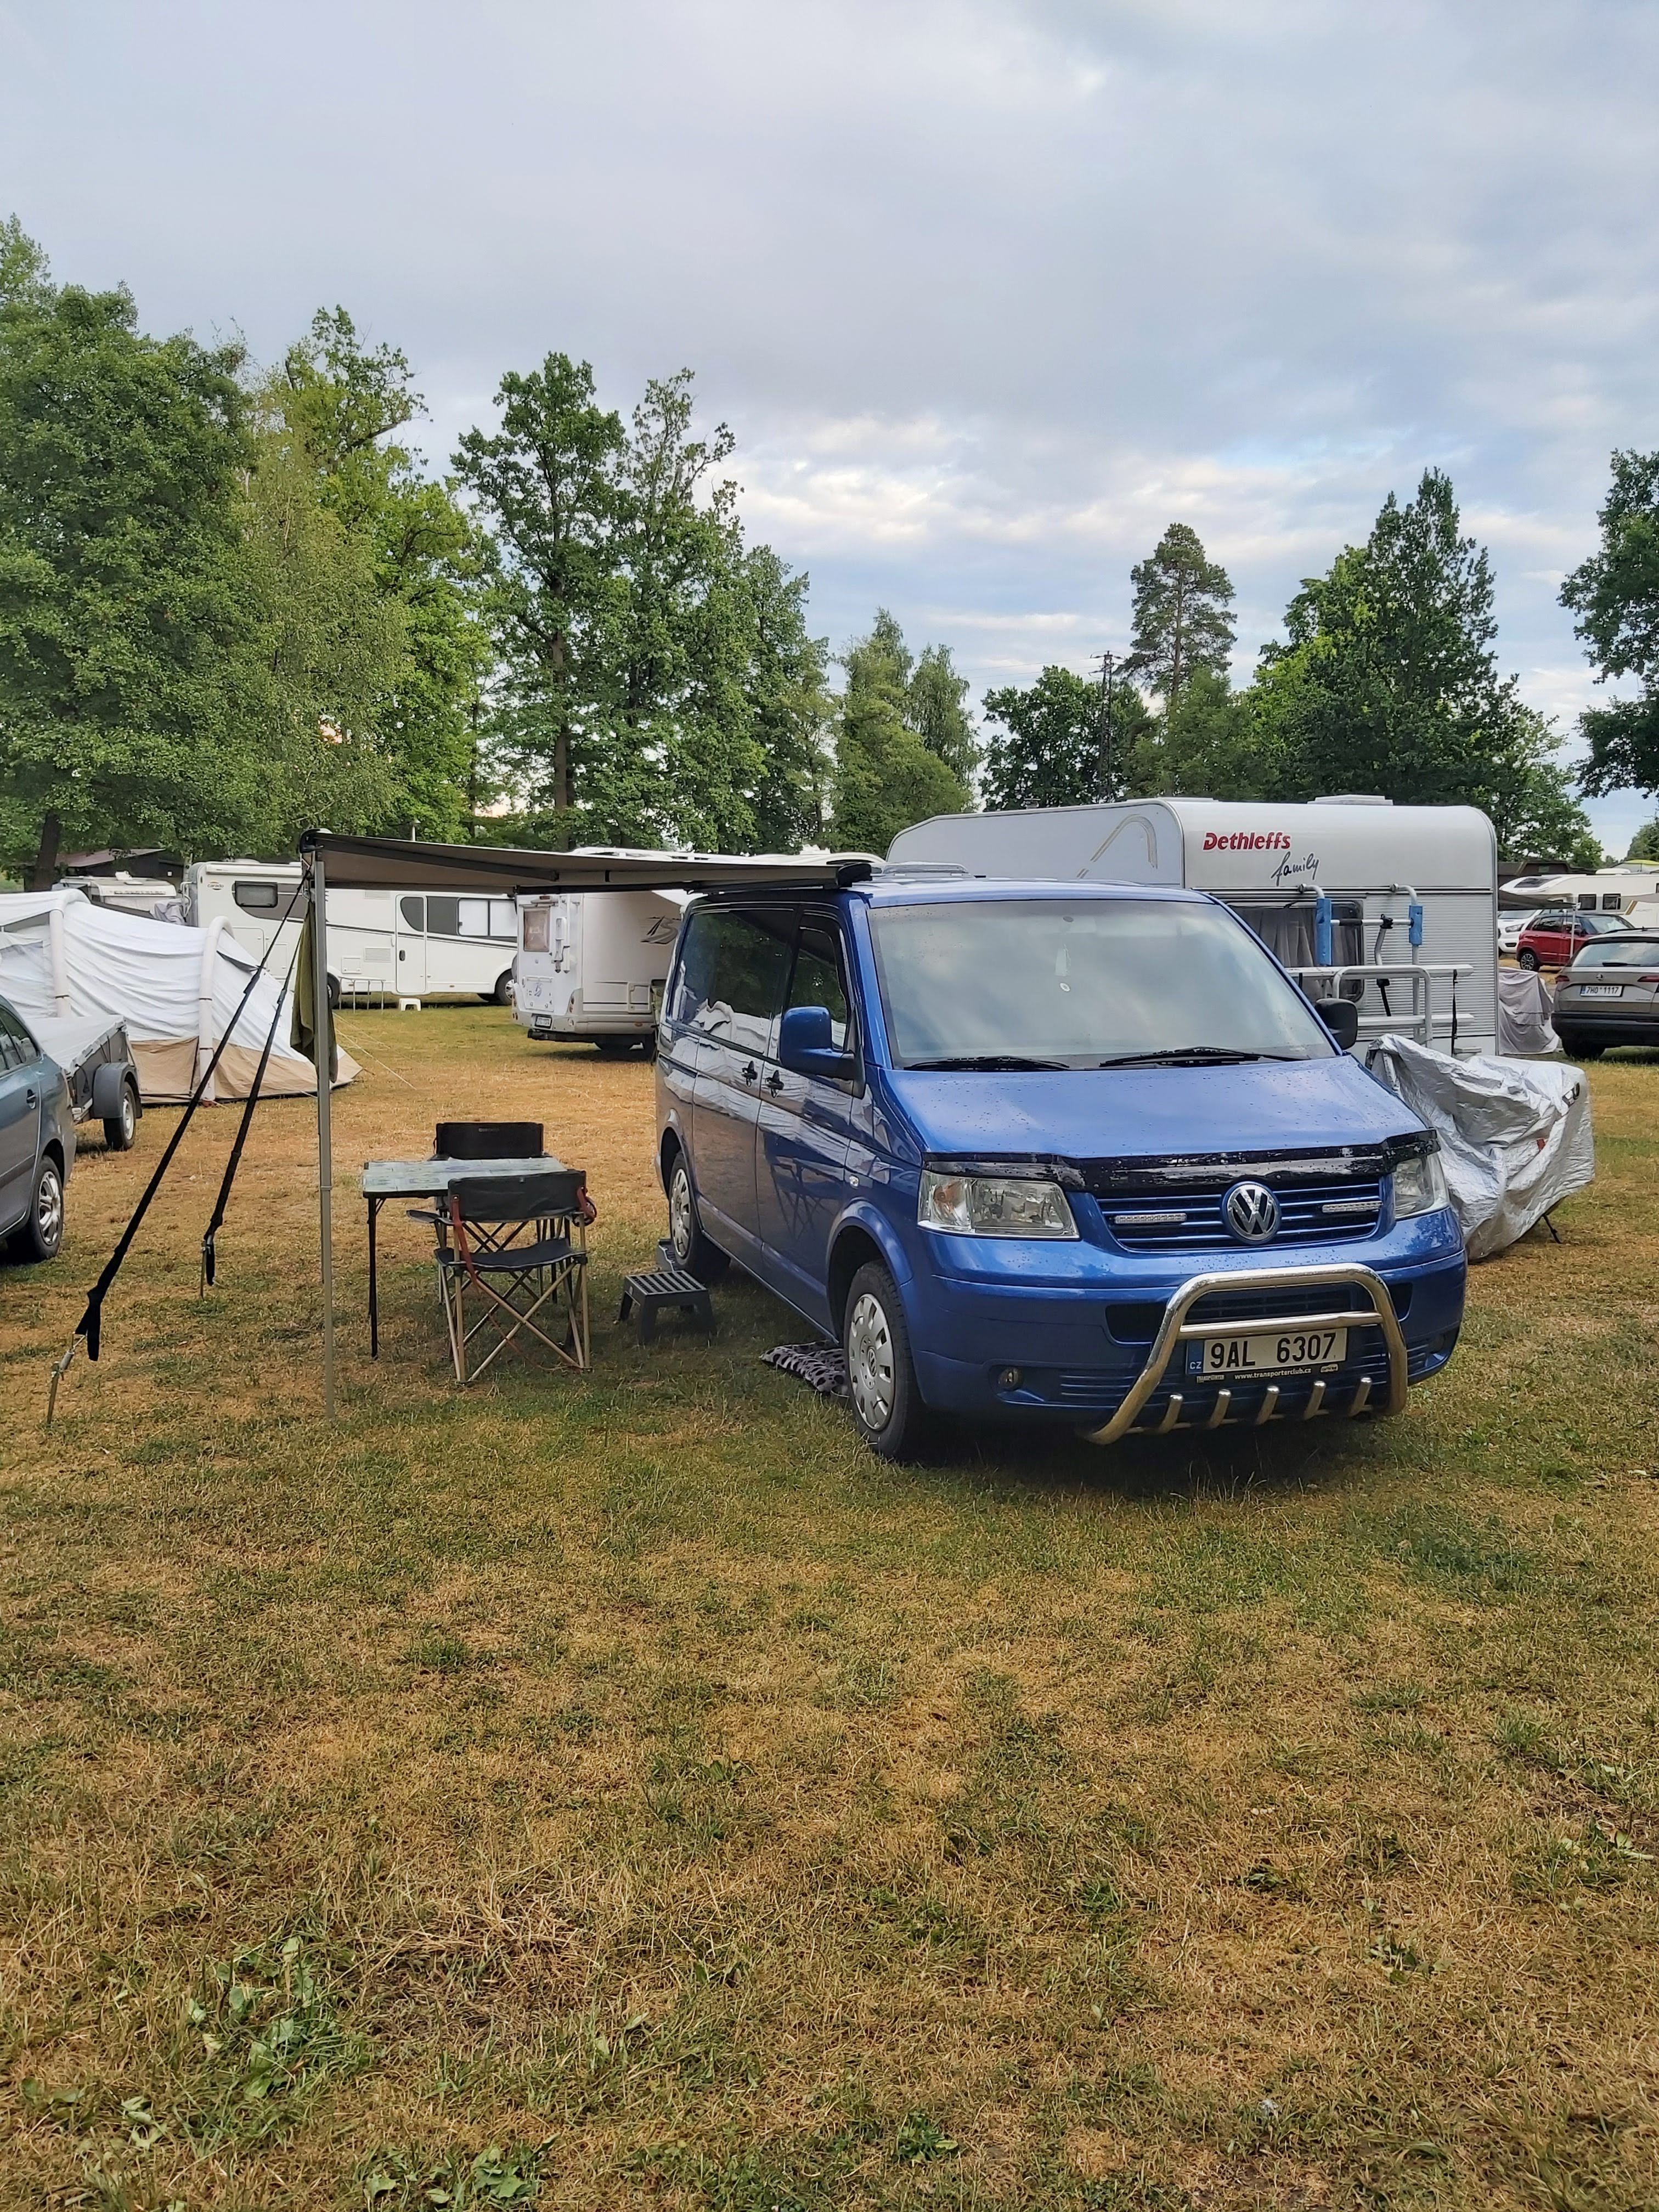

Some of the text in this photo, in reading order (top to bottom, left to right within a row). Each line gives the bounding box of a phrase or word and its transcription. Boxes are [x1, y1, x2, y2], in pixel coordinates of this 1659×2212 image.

[1203, 832, 1291, 850] Dethleffs
[1270, 851, 1319, 887] family
[1210, 1332, 1336, 1369] 9AL 6307
[1189, 1361, 1202, 1370] CZ
[1234, 1367, 1312, 1380] www.transporterclub.cz
